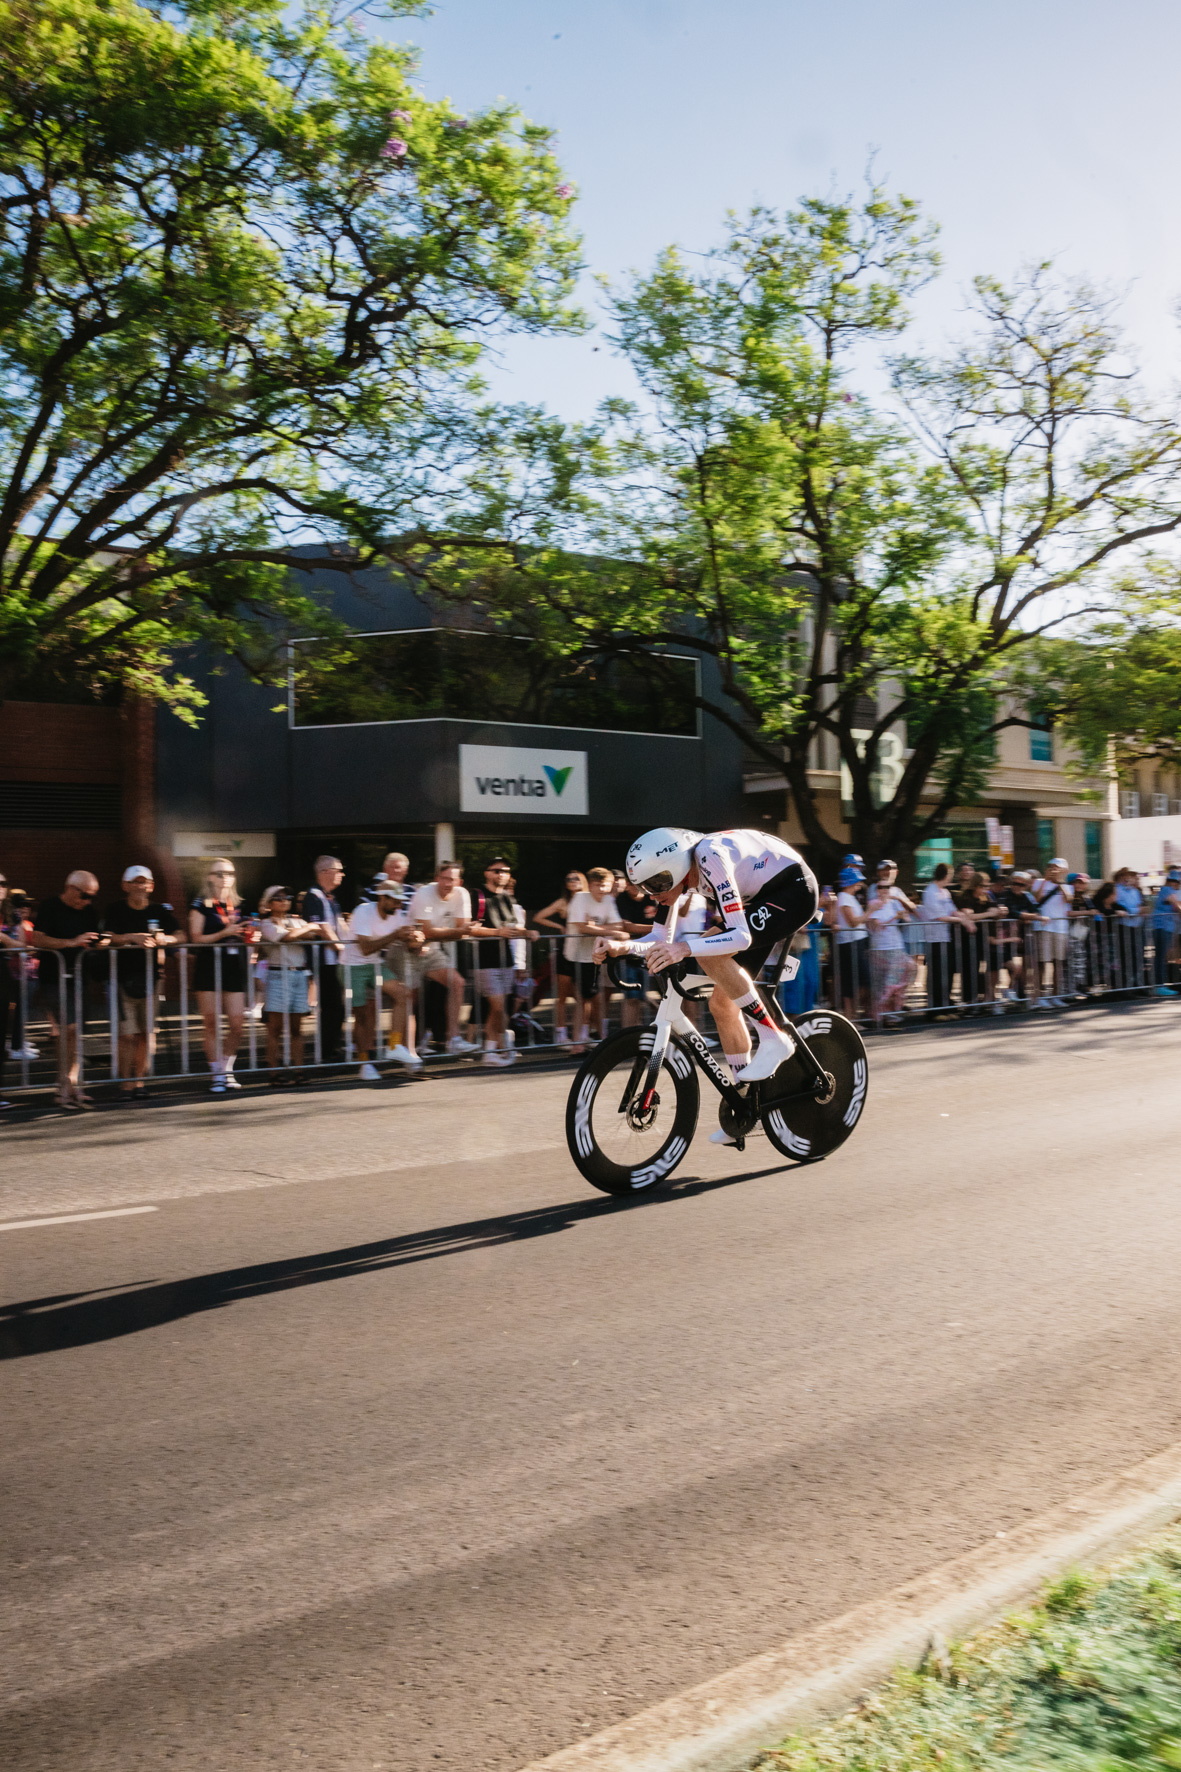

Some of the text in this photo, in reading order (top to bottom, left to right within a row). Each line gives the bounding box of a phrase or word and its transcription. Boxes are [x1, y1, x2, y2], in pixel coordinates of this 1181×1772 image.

[474, 774, 547, 797] ventia
[655, 841, 679, 857] MET
[753, 860, 765, 871] FAB
[716, 880, 731, 892] FAB
[750, 906, 772, 931] G42
[690, 1034, 730, 1087] COLNAGO
